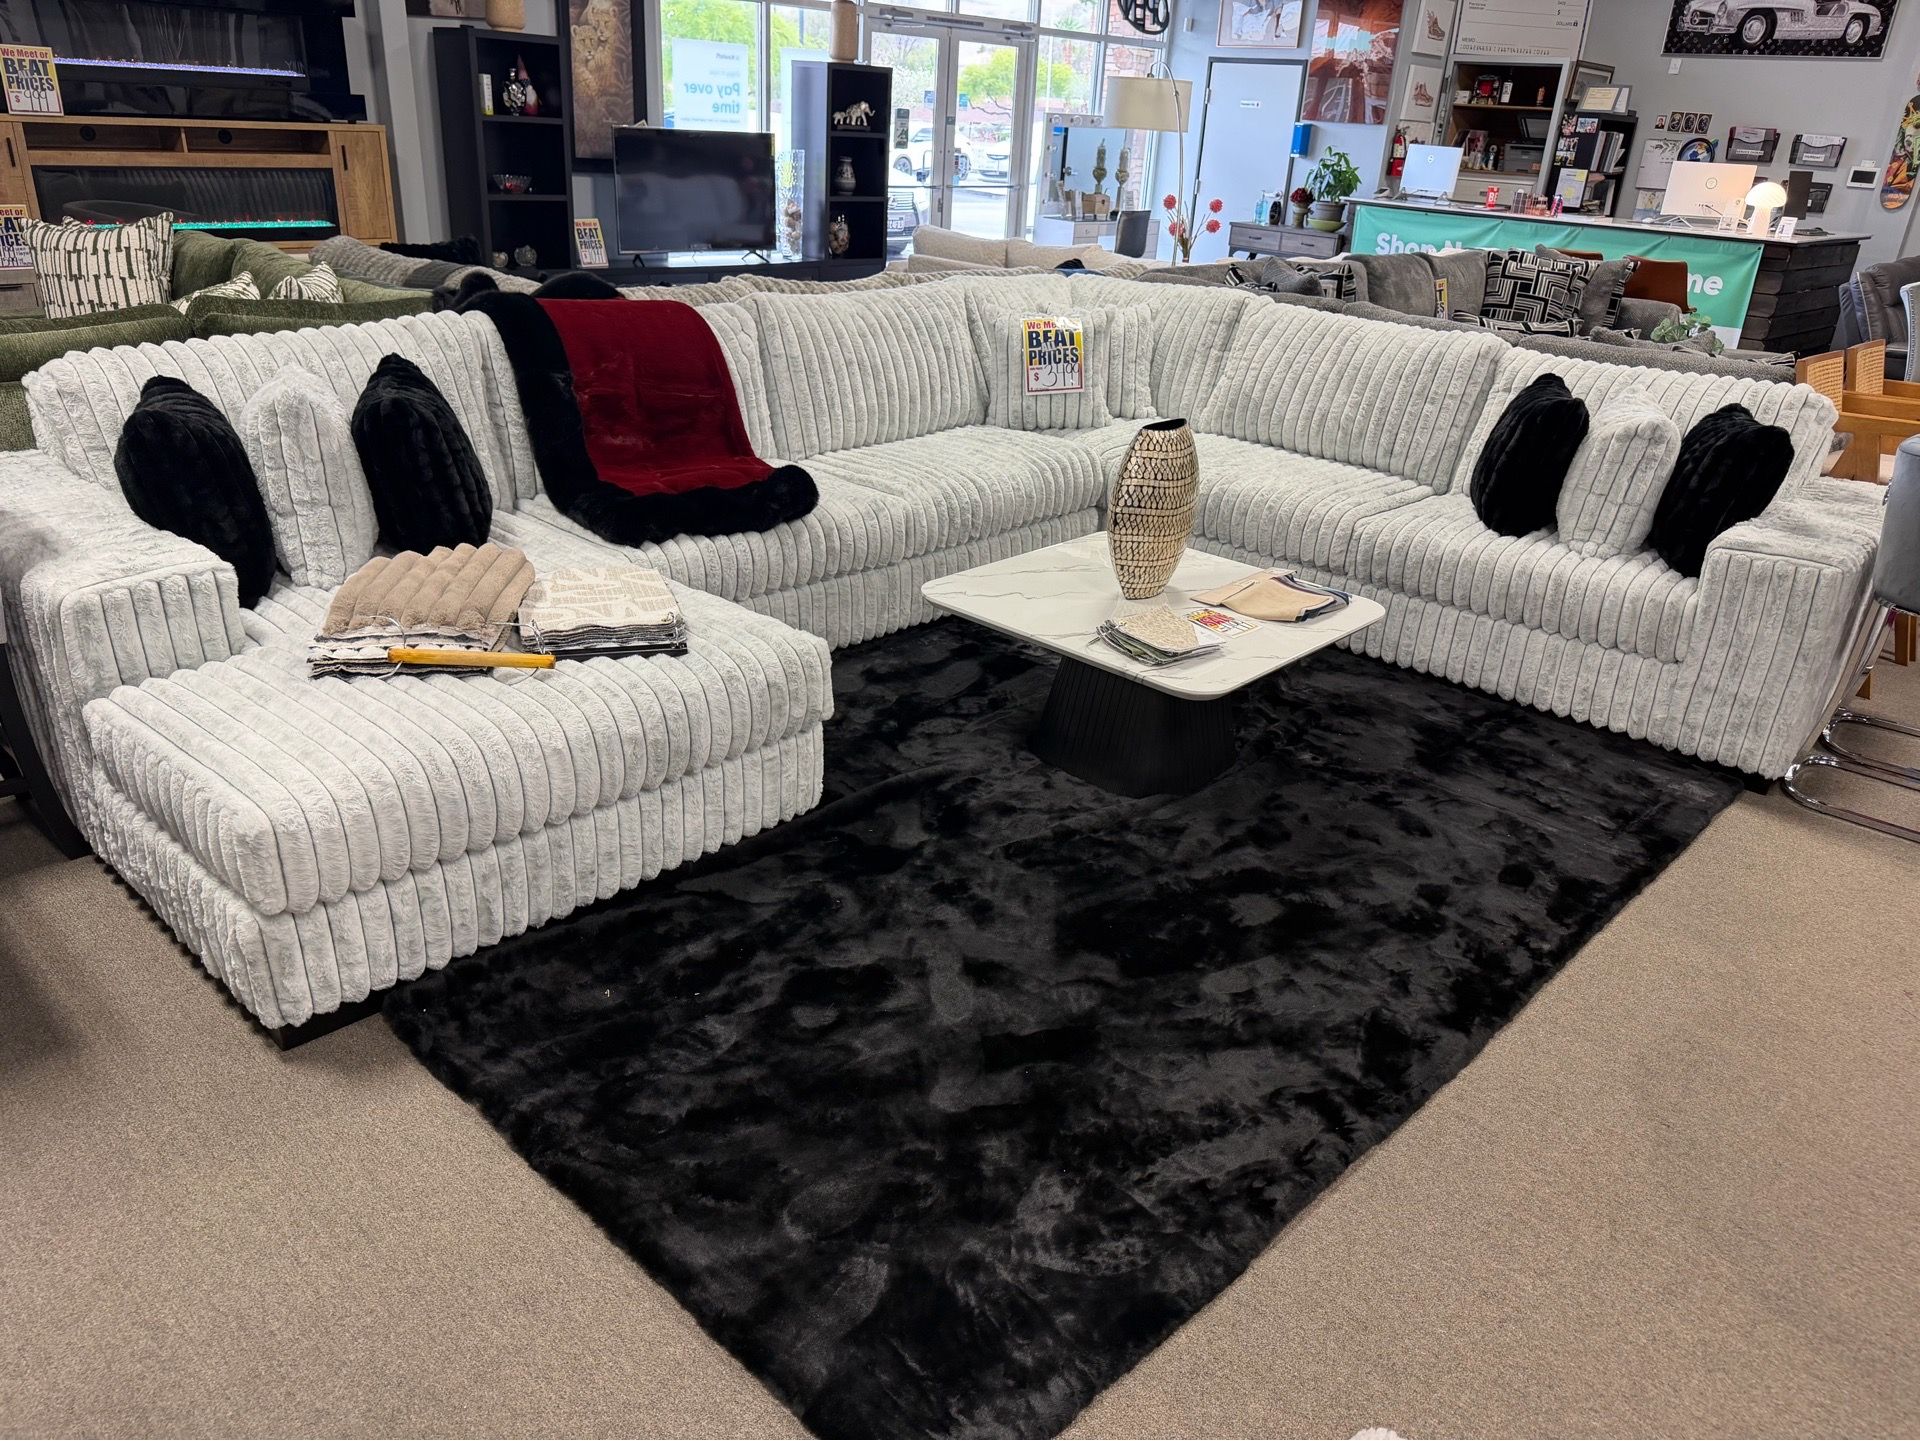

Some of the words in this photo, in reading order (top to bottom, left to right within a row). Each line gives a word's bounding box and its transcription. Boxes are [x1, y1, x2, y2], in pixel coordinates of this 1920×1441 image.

[0, 48, 15, 57] We
[17, 49, 38, 58] Meet
[3, 58, 49, 76] BEAT
[7, 75, 55, 91] PRICES
[577, 228, 599, 239] BEAT
[1027, 321, 1041, 329] We
[1044, 321, 1057, 329] Me
[1028, 329, 1075, 348] BEAT
[1029, 347, 1079, 366] PRICES
[1034, 372, 1040, 382] $
